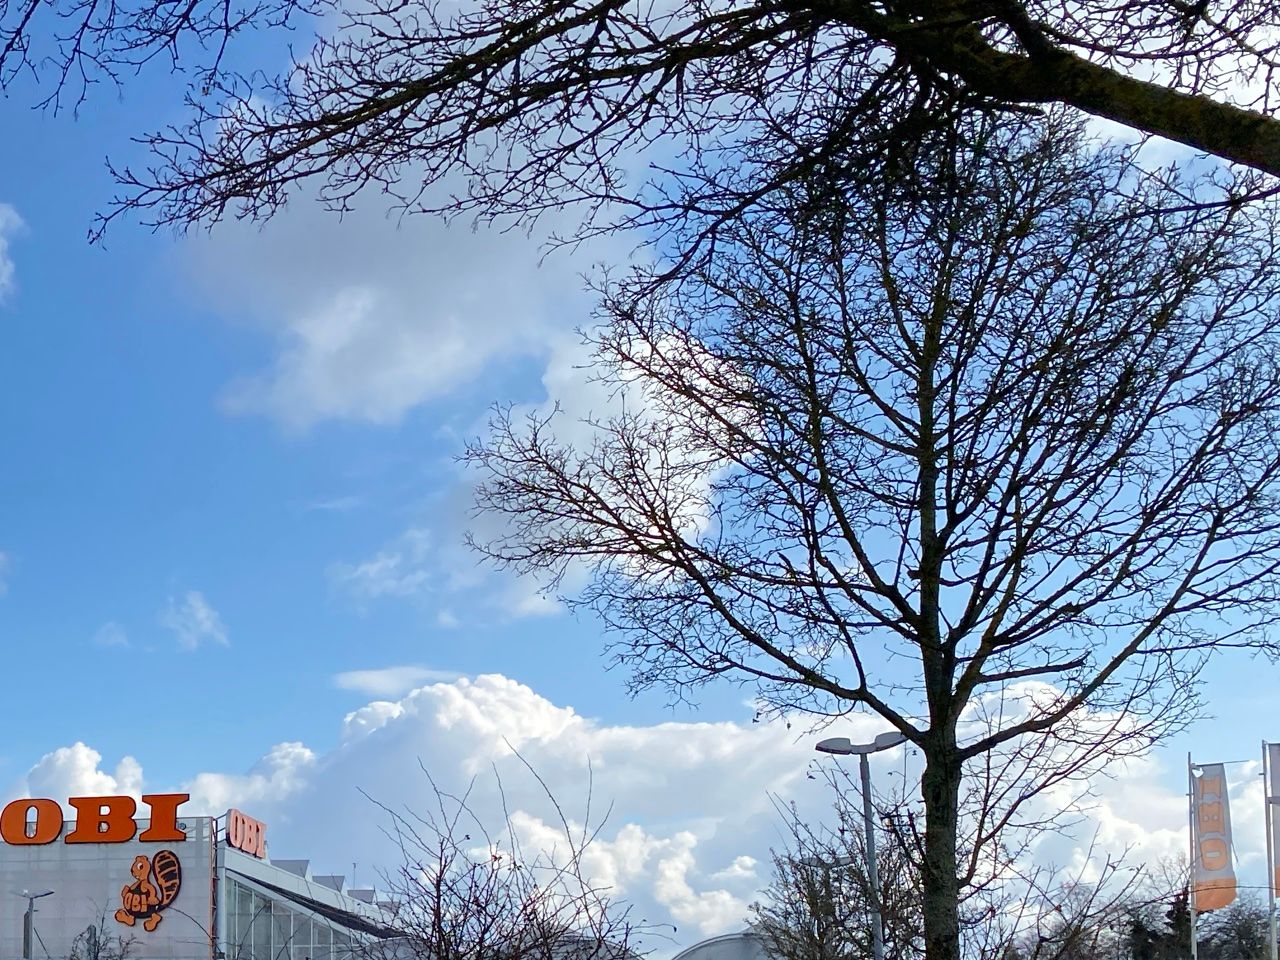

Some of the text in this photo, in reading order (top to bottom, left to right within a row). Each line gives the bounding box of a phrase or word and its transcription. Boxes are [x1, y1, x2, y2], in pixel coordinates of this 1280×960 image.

[0, 793, 190, 845] OBI
[226, 808, 267, 859] OBI
[1198, 777, 1229, 871] OBI
[124, 892, 148, 913] OBI
